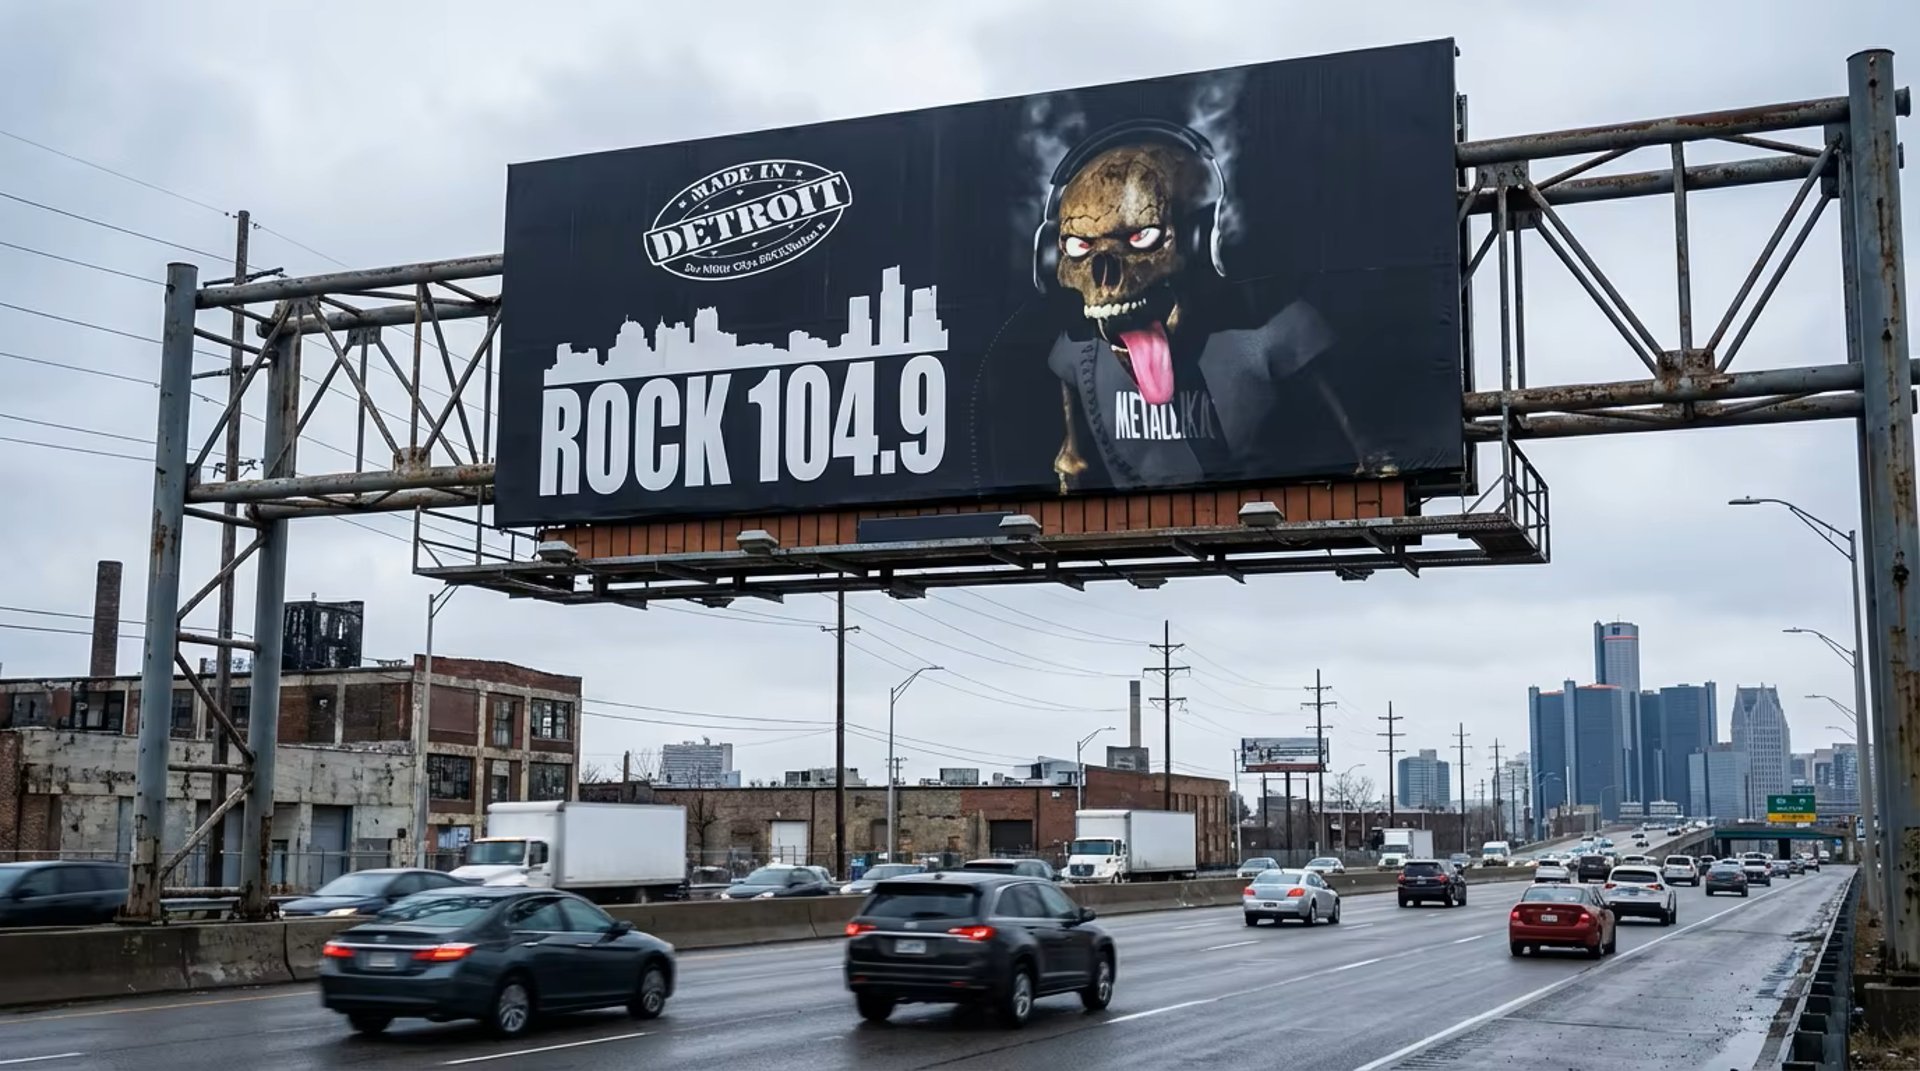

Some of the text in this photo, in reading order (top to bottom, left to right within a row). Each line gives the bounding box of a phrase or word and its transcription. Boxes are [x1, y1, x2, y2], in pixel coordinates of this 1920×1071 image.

[651, 177, 842, 260] DETROIT
[691, 163, 787, 202] MADE IN
[540, 355, 946, 496] ROCK 104.9
